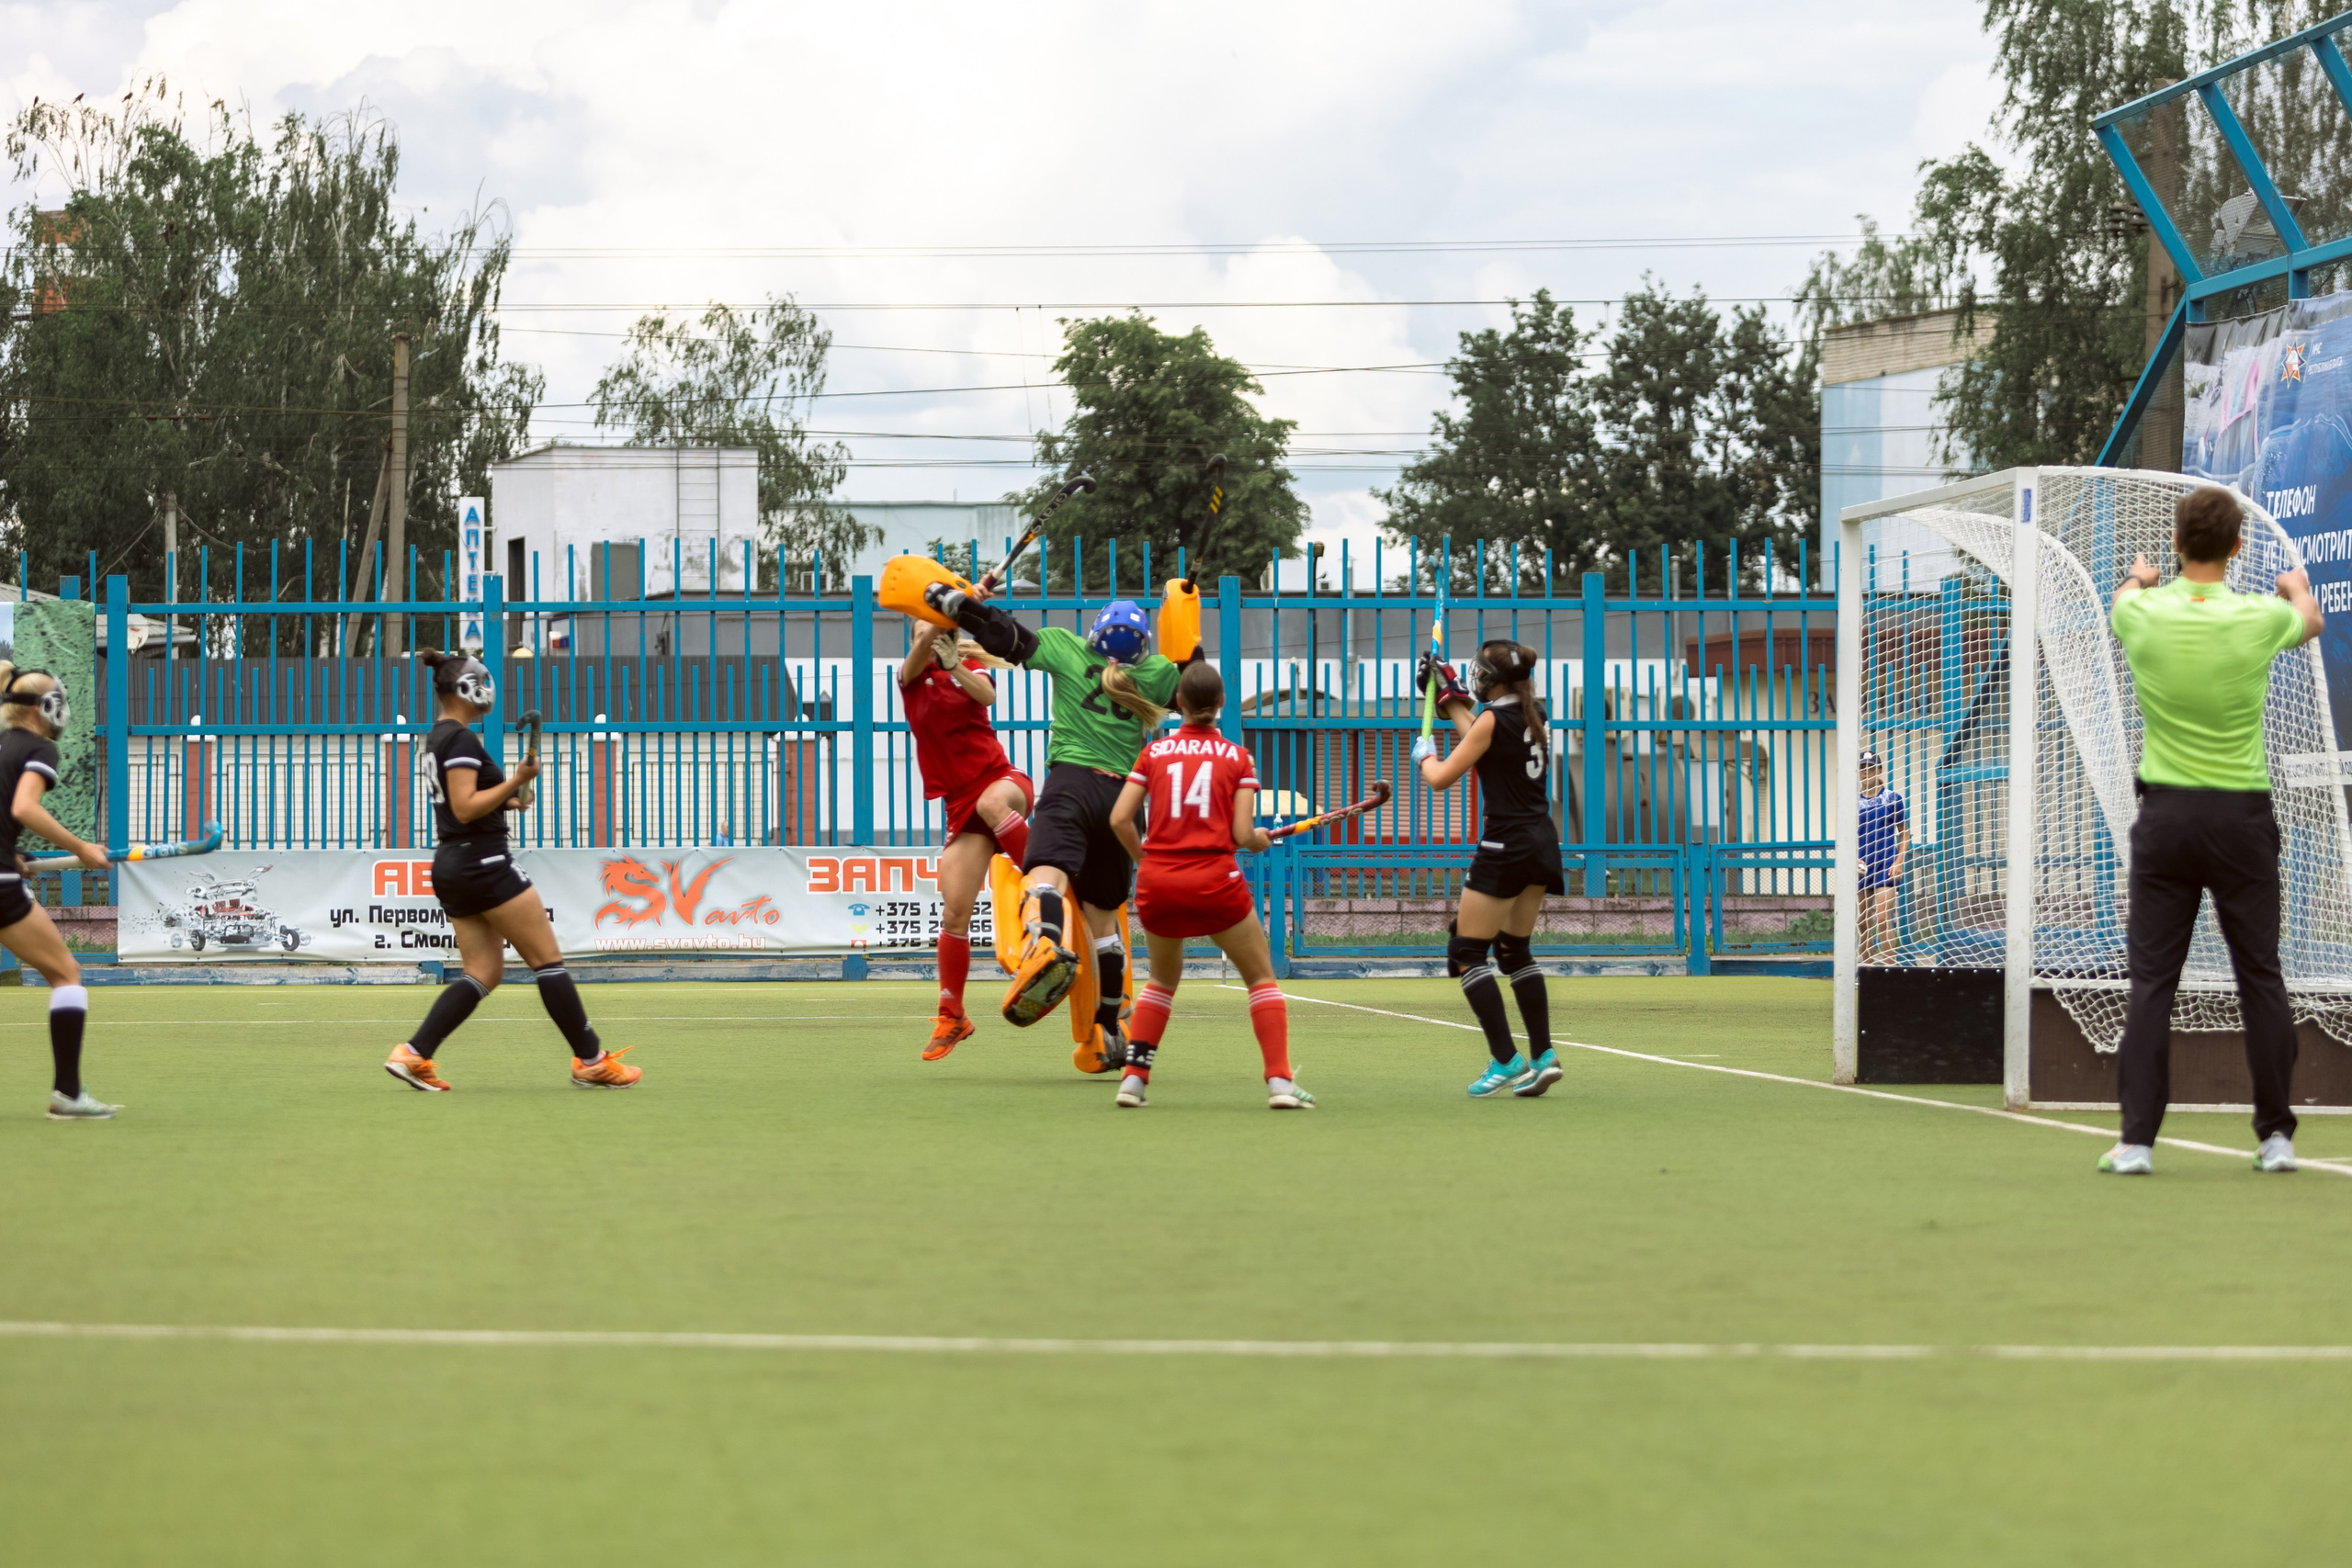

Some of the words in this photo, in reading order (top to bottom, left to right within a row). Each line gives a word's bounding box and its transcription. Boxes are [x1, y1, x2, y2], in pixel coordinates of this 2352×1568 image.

[2267, 484, 2316, 520] ТЕЛЕФОН
[2278, 529, 2352, 569] ПИСМОТРИТ
[1149, 739, 1239, 761] SIDARAVA
[1166, 760, 1214, 818] 14
[807, 856, 993, 894] ЗАПЧ
[330, 908, 359, 928] ул.
[876, 902, 921, 917] +375
[876, 920, 922, 934] +375
[969, 919, 992, 933] 66
[374, 934, 391, 949] г.
